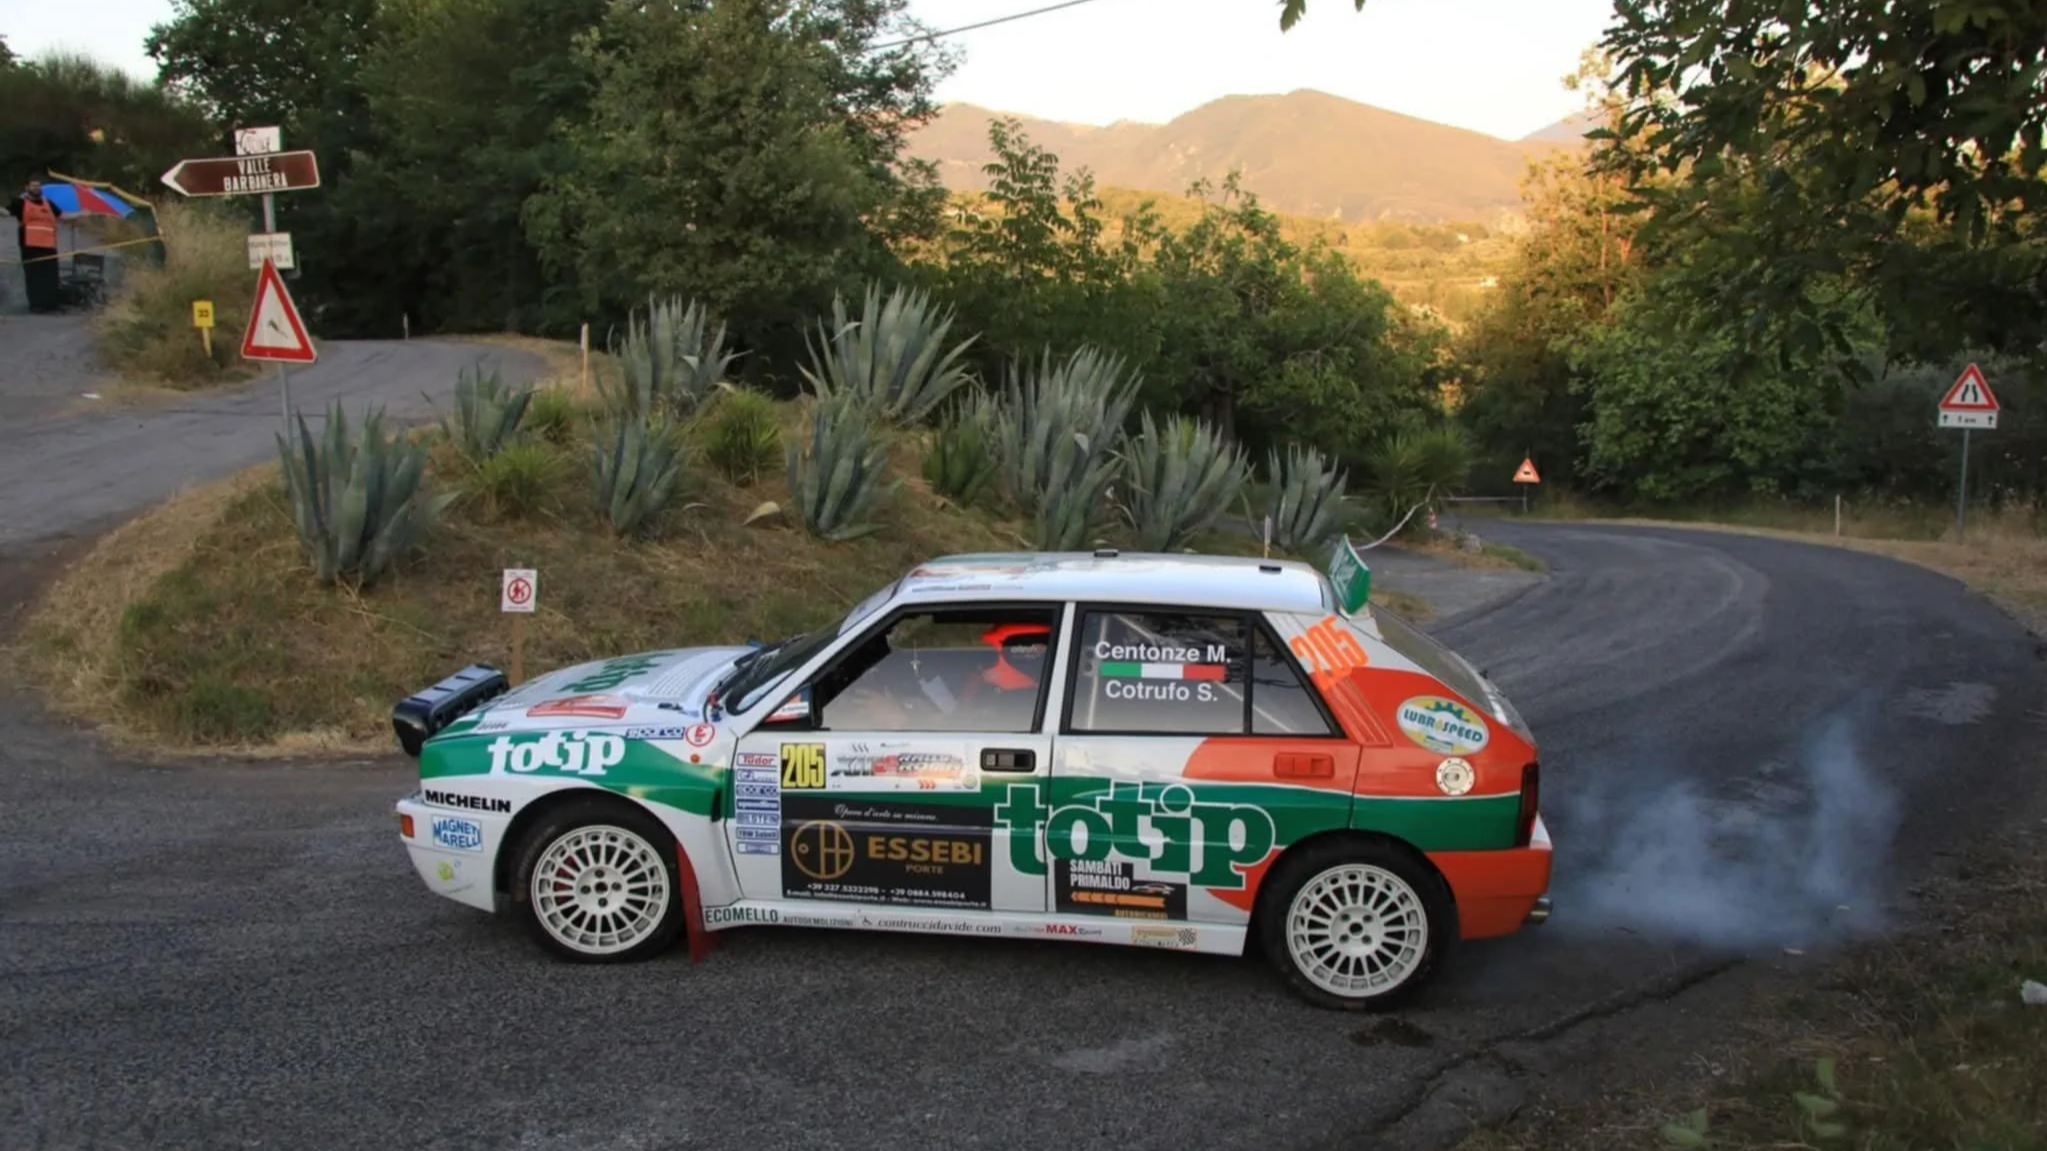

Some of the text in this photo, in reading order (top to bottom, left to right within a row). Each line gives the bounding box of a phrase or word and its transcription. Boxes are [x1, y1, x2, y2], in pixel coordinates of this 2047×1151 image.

[238, 158, 271, 175] VALLE
[1095, 641, 1232, 664] Centonze M.
[1290, 614, 1370, 691] 205
[1105, 680, 1218, 702] Cotrufo S.
[488, 728, 626, 776] totip
[782, 744, 825, 788] 205
[425, 789, 512, 813] MICHELIN
[994, 778, 1276, 891] totip
[867, 837, 982, 865] ESSEBI
[905, 864, 944, 875] PORTE
[1069, 859, 1123, 875] SAMBATI
[1070, 873, 1131, 891] PRIMALDO
[705, 906, 779, 924] ECOMELLO
[1045, 924, 1079, 935] MAX
